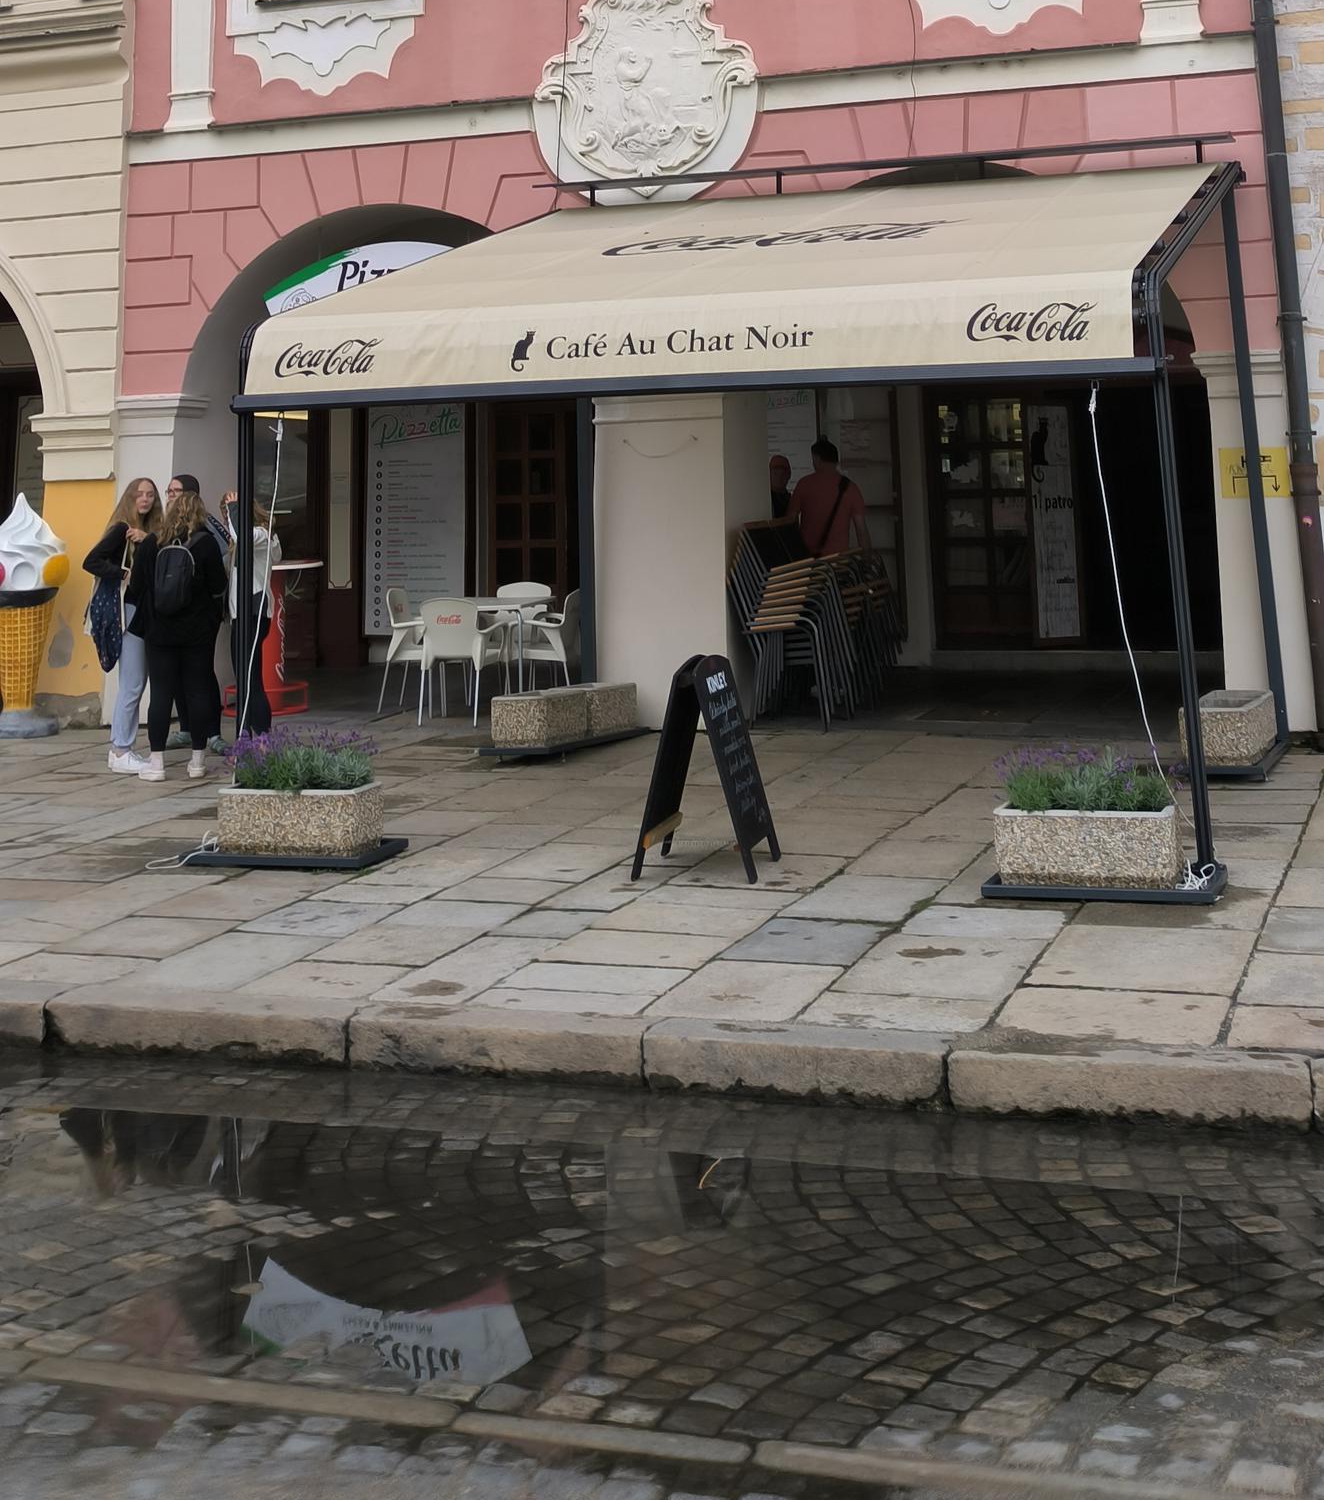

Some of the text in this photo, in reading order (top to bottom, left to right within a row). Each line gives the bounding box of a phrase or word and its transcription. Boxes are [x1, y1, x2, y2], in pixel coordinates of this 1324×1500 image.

[601, 218, 970, 256] Coca-Cola
[966, 301, 1098, 343] Coca-Cola
[274, 338, 383, 378] Coca-Cola
[546, 323, 814, 360] Café Au Chat Noir
[371, 407, 461, 449] Pizzetta
[1045, 495, 1073, 513] patro
[705, 670, 728, 694] KINLEY
